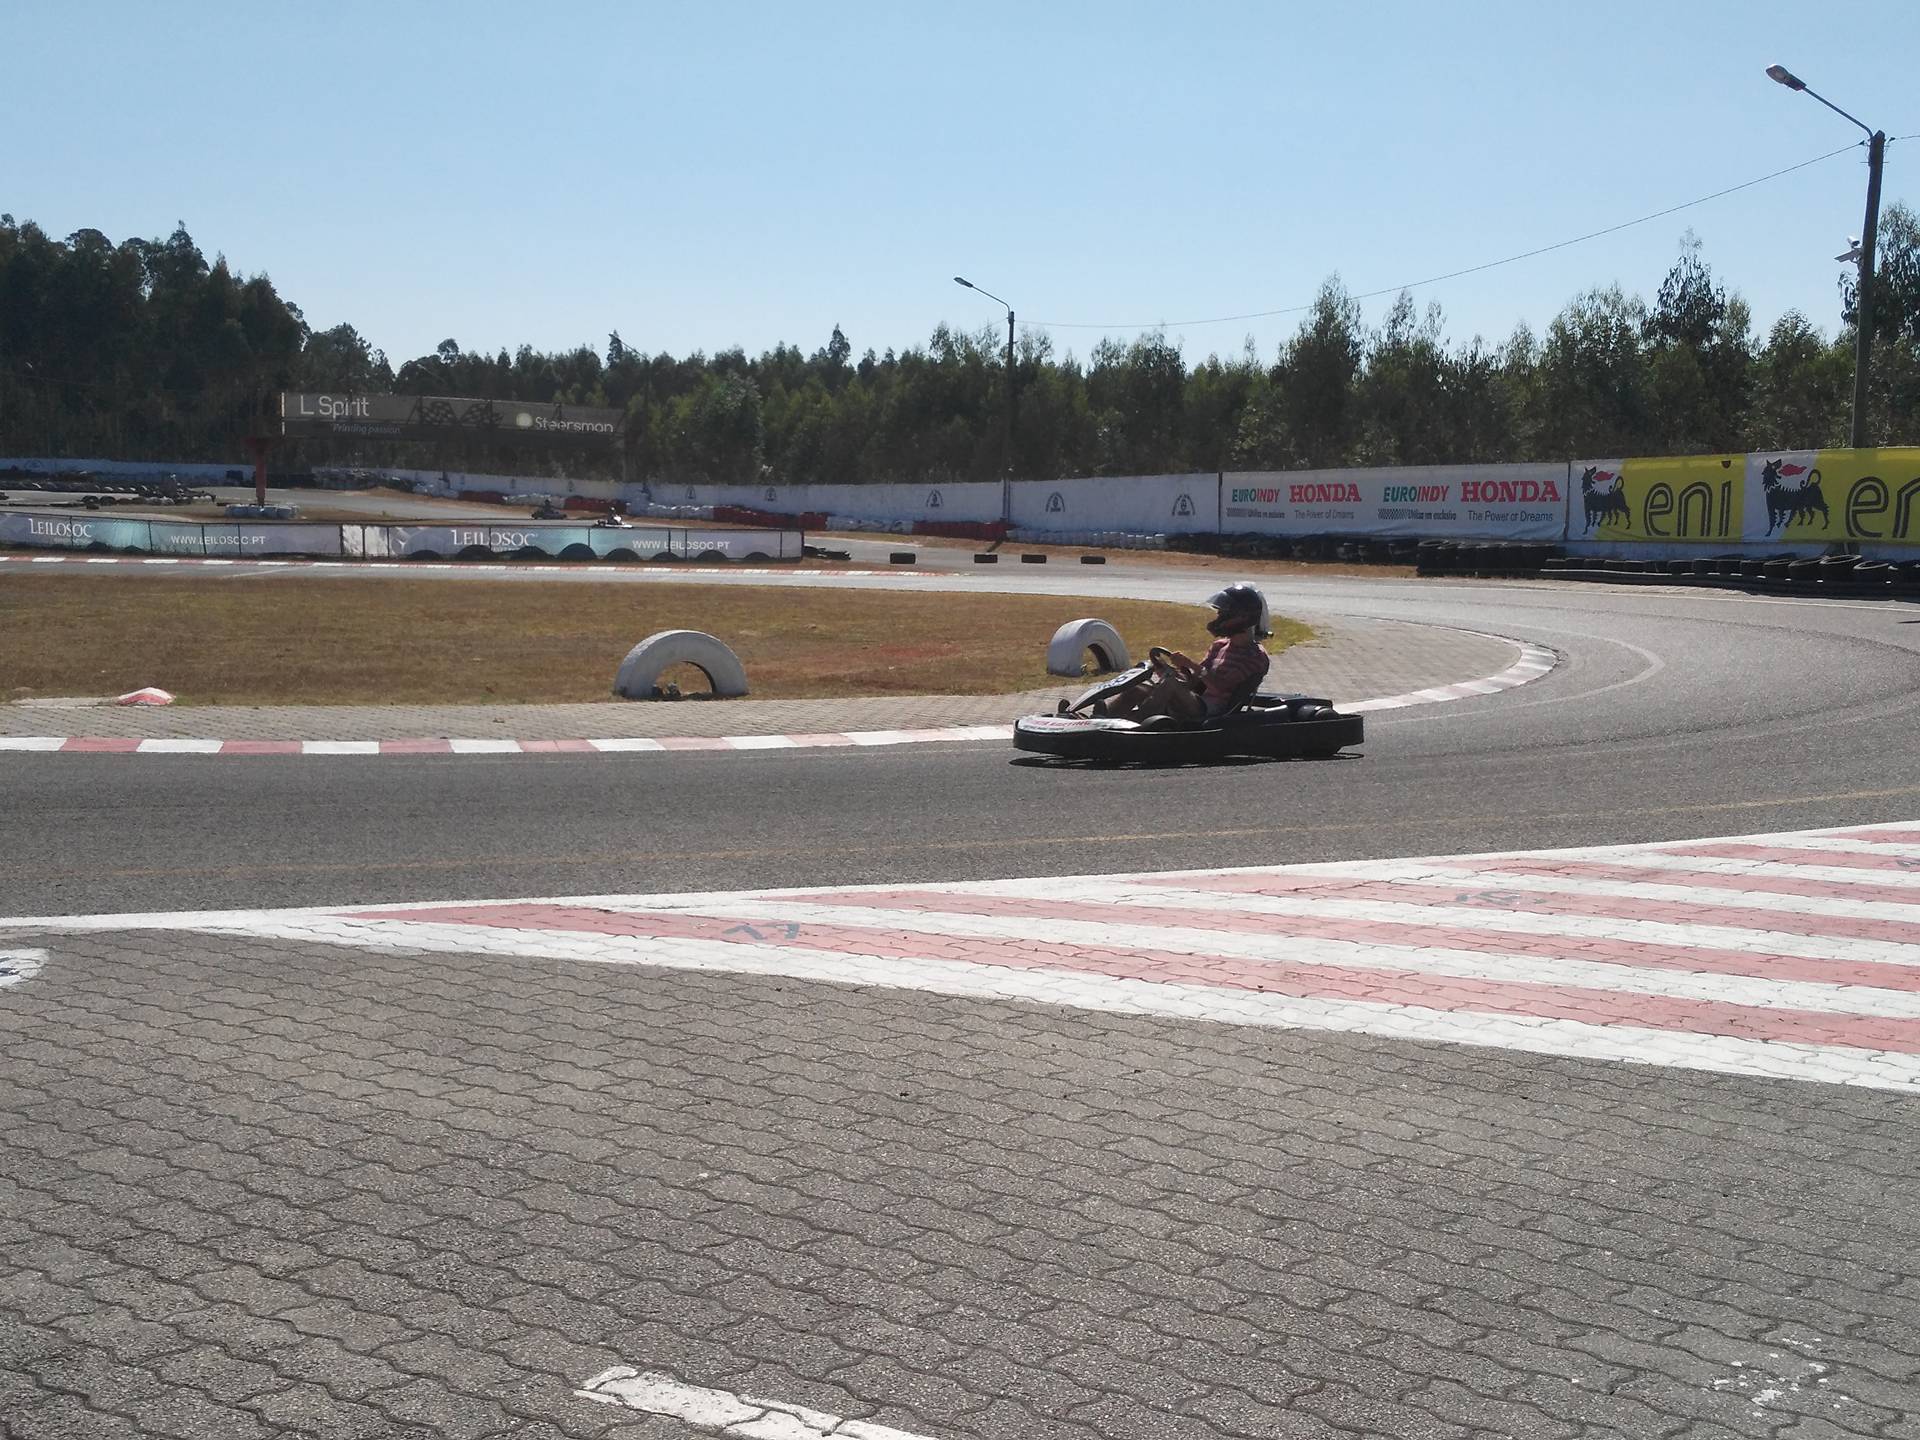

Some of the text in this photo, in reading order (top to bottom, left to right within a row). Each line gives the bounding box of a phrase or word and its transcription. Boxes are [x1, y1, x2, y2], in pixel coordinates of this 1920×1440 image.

[300, 395, 370, 419] L Spirit
[535, 416, 614, 433] Steersman
[1232, 488, 1280, 502] EUROINDY
[1289, 484, 1362, 502] HONDA
[1383, 486, 1449, 502] EUROINDY
[1461, 481, 1561, 502] HONDA
[1643, 460, 1731, 536] eni
[1294, 510, 1305, 519] The
[1306, 511, 1323, 519] Power
[1468, 510, 1482, 521] The
[1484, 511, 1509, 522] Power
[1520, 510, 1553, 522] Dreams
[28, 518, 92, 538] LEILOSOC
[450, 529, 536, 546] LEILOSOC
